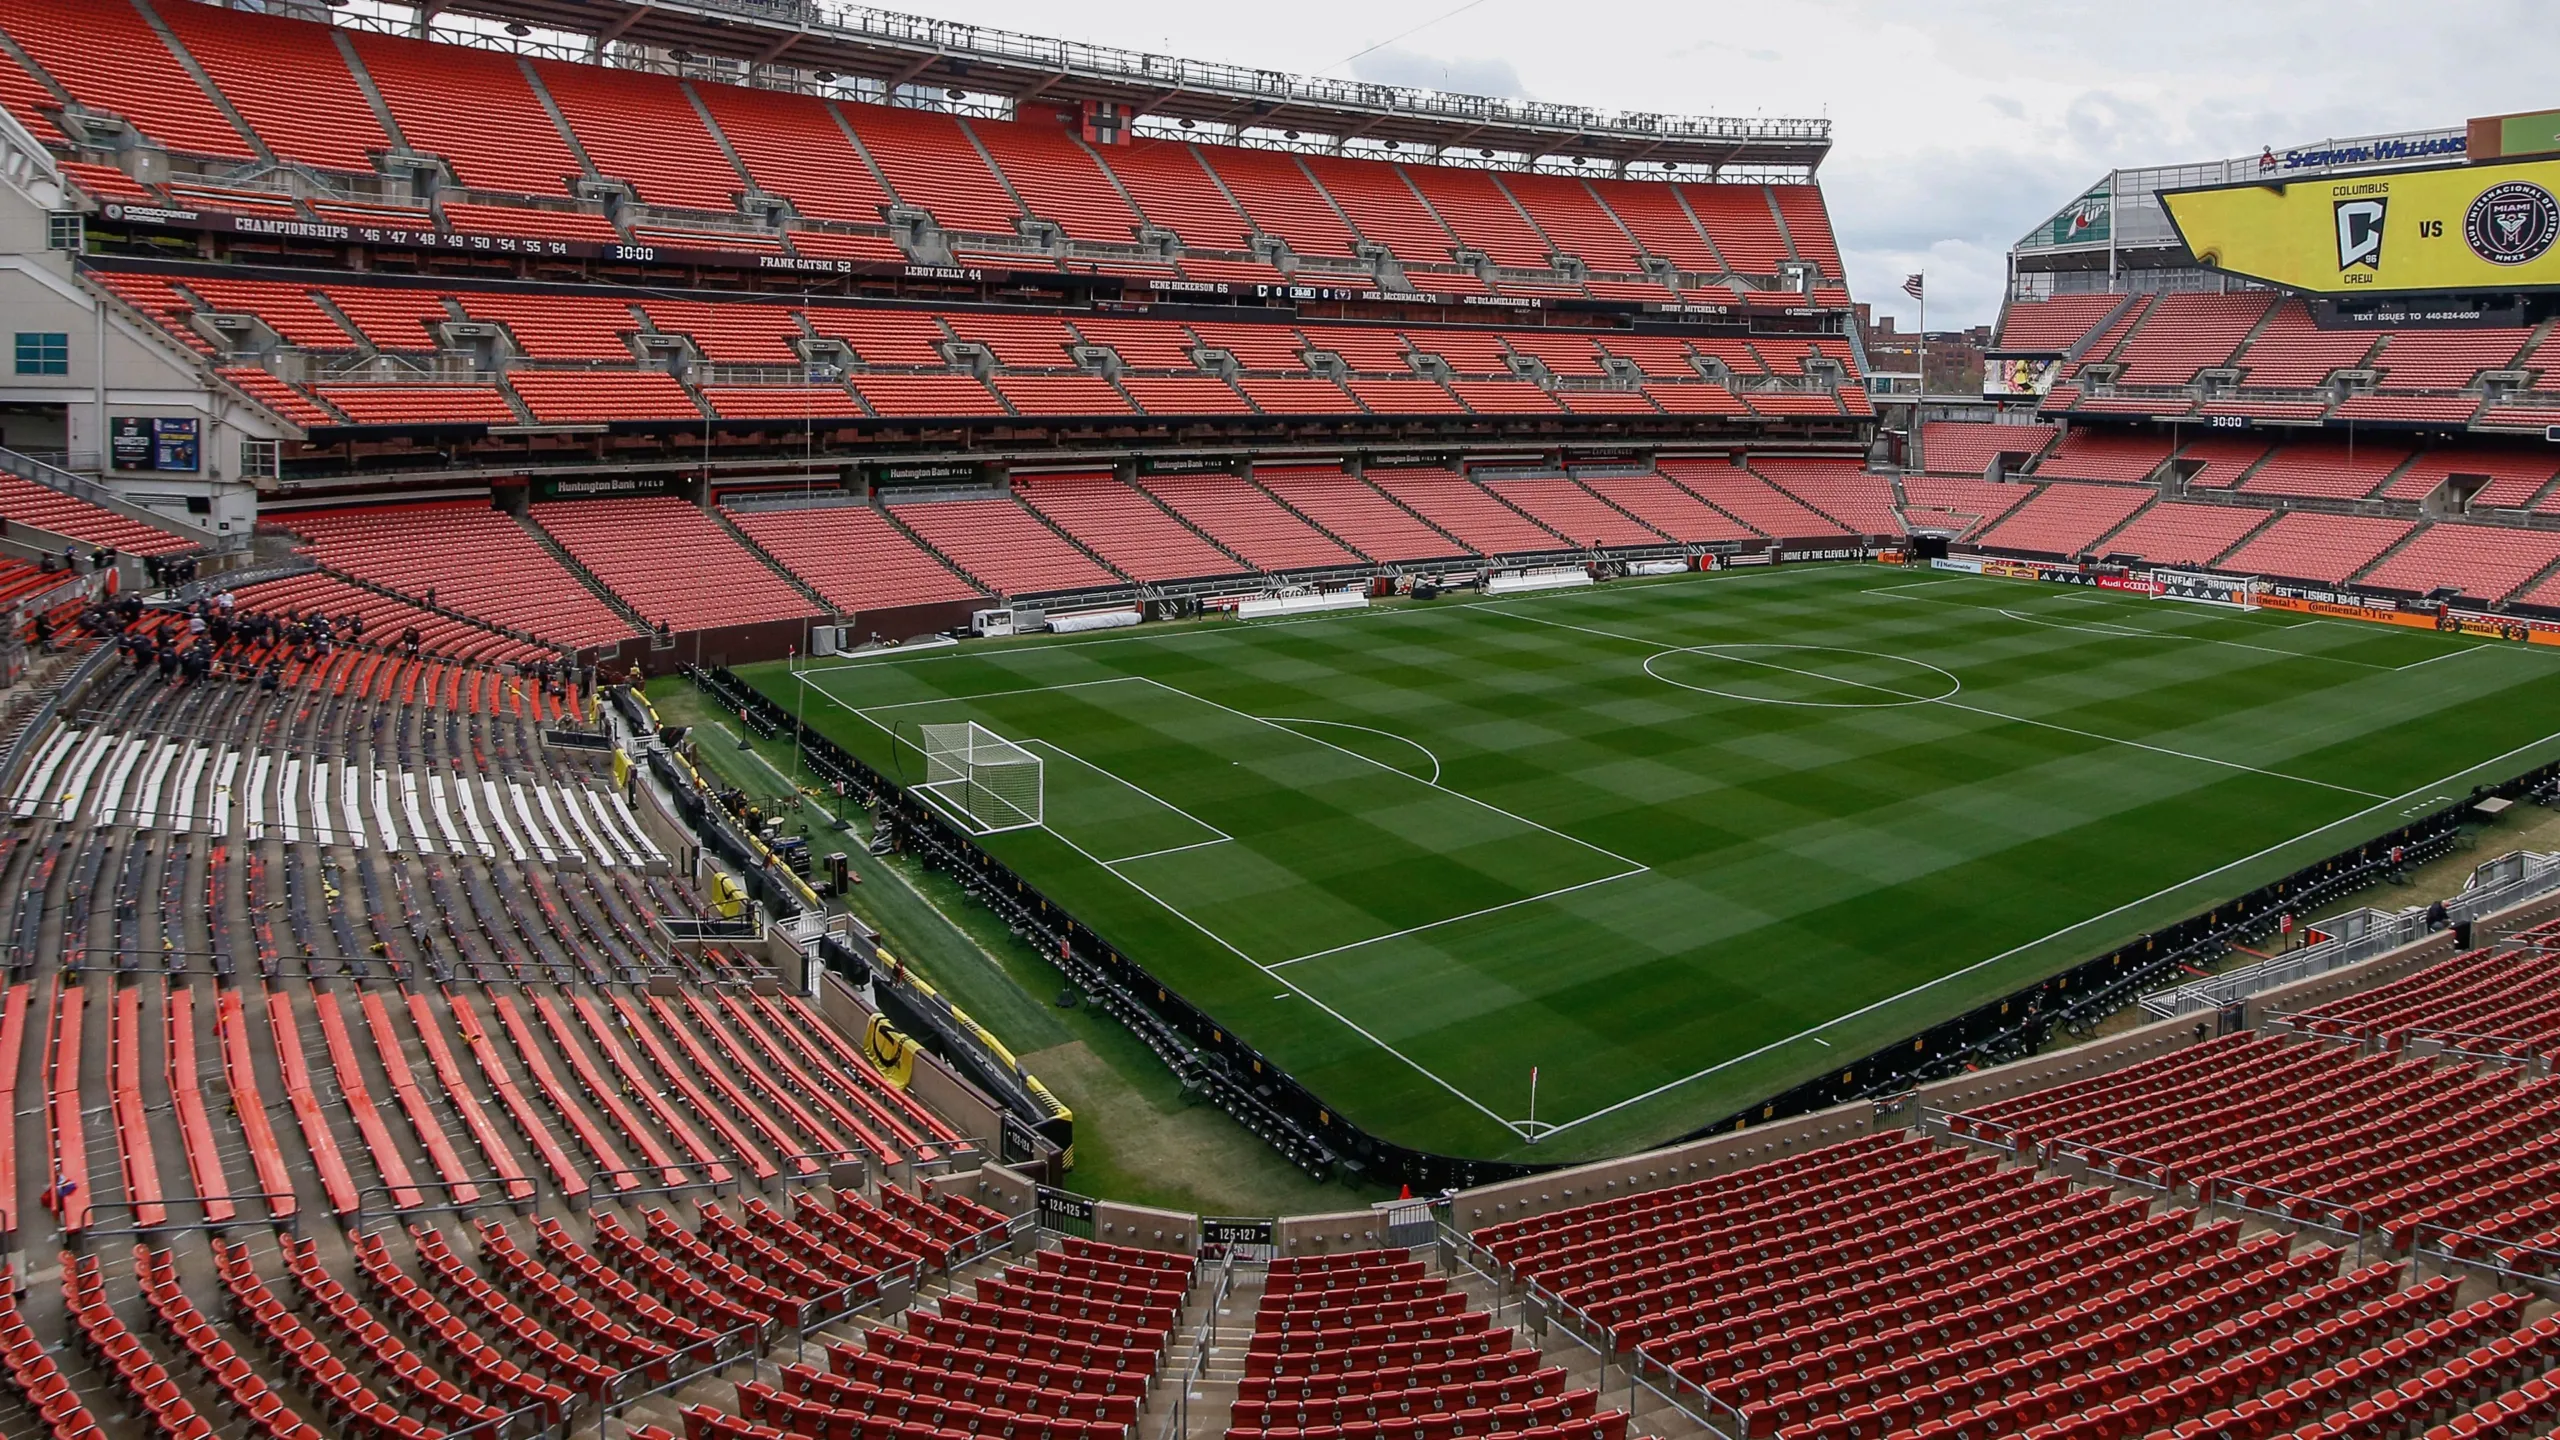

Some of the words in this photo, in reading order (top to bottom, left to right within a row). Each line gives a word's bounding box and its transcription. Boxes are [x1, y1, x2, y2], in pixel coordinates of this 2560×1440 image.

[2284, 137, 2467, 169] SHERWIN-WILLIAMS
[2332, 182, 2389, 197] COLUMBUS
[2468, 185, 2542, 222] INTERNACIONAL
[2493, 203, 2531, 213] MIAMI
[2542, 197, 2554, 209] DE
[123, 205, 199, 220] CROSSCOUNTRY
[235, 217, 349, 239] CHAMPIONSHIPS
[2419, 220, 2443, 238] VS
[2467, 226, 2481, 247] CLUB
[616, 245, 654, 261] 30:00
[2365, 254, 2377, 264] 96
[2494, 253, 2527, 262] MMXX
[760, 256, 795, 270] FRANK
[797, 259, 833, 272] GATSKI
[837, 261, 851, 273] 52
[905, 266, 934, 277] LEROY
[936, 267, 965, 279] KELLY
[968, 269, 982, 281] 44
[2344, 273, 2373, 284] CREW
[1150, 280, 1171, 290] GENE
[1171, 281, 1214, 292] HICKERSON
[1217, 283, 1228, 294] 66
[1362, 291, 1381, 300] MIKE
[1427, 293, 1436, 303] 74
[2353, 313, 2374, 321] TEXT
[2377, 313, 2405, 321] ISSUES
[2409, 312, 2421, 320] TO
[2425, 311, 2480, 320] 440-824-6000
[2212, 416, 2242, 428] 30:00
[890, 469, 931, 479] Huntington
[931, 467, 950, 476] Bank
[558, 481, 611, 493] Huntington
[611, 480, 635, 490] Bank
[1783, 552, 1800, 561] HOME
[1802, 551, 1811, 560] OF
[1812, 550, 1823, 559] THE
[1943, 562, 1972, 571] Nationwide
[2101, 579, 2121, 588] Audi
[2275, 586, 2335, 603] ESTLISHED
[2337, 593, 2361, 606] 1946
[2308, 601, 2362, 618] Continental
[2371, 610, 2394, 622] Tire
